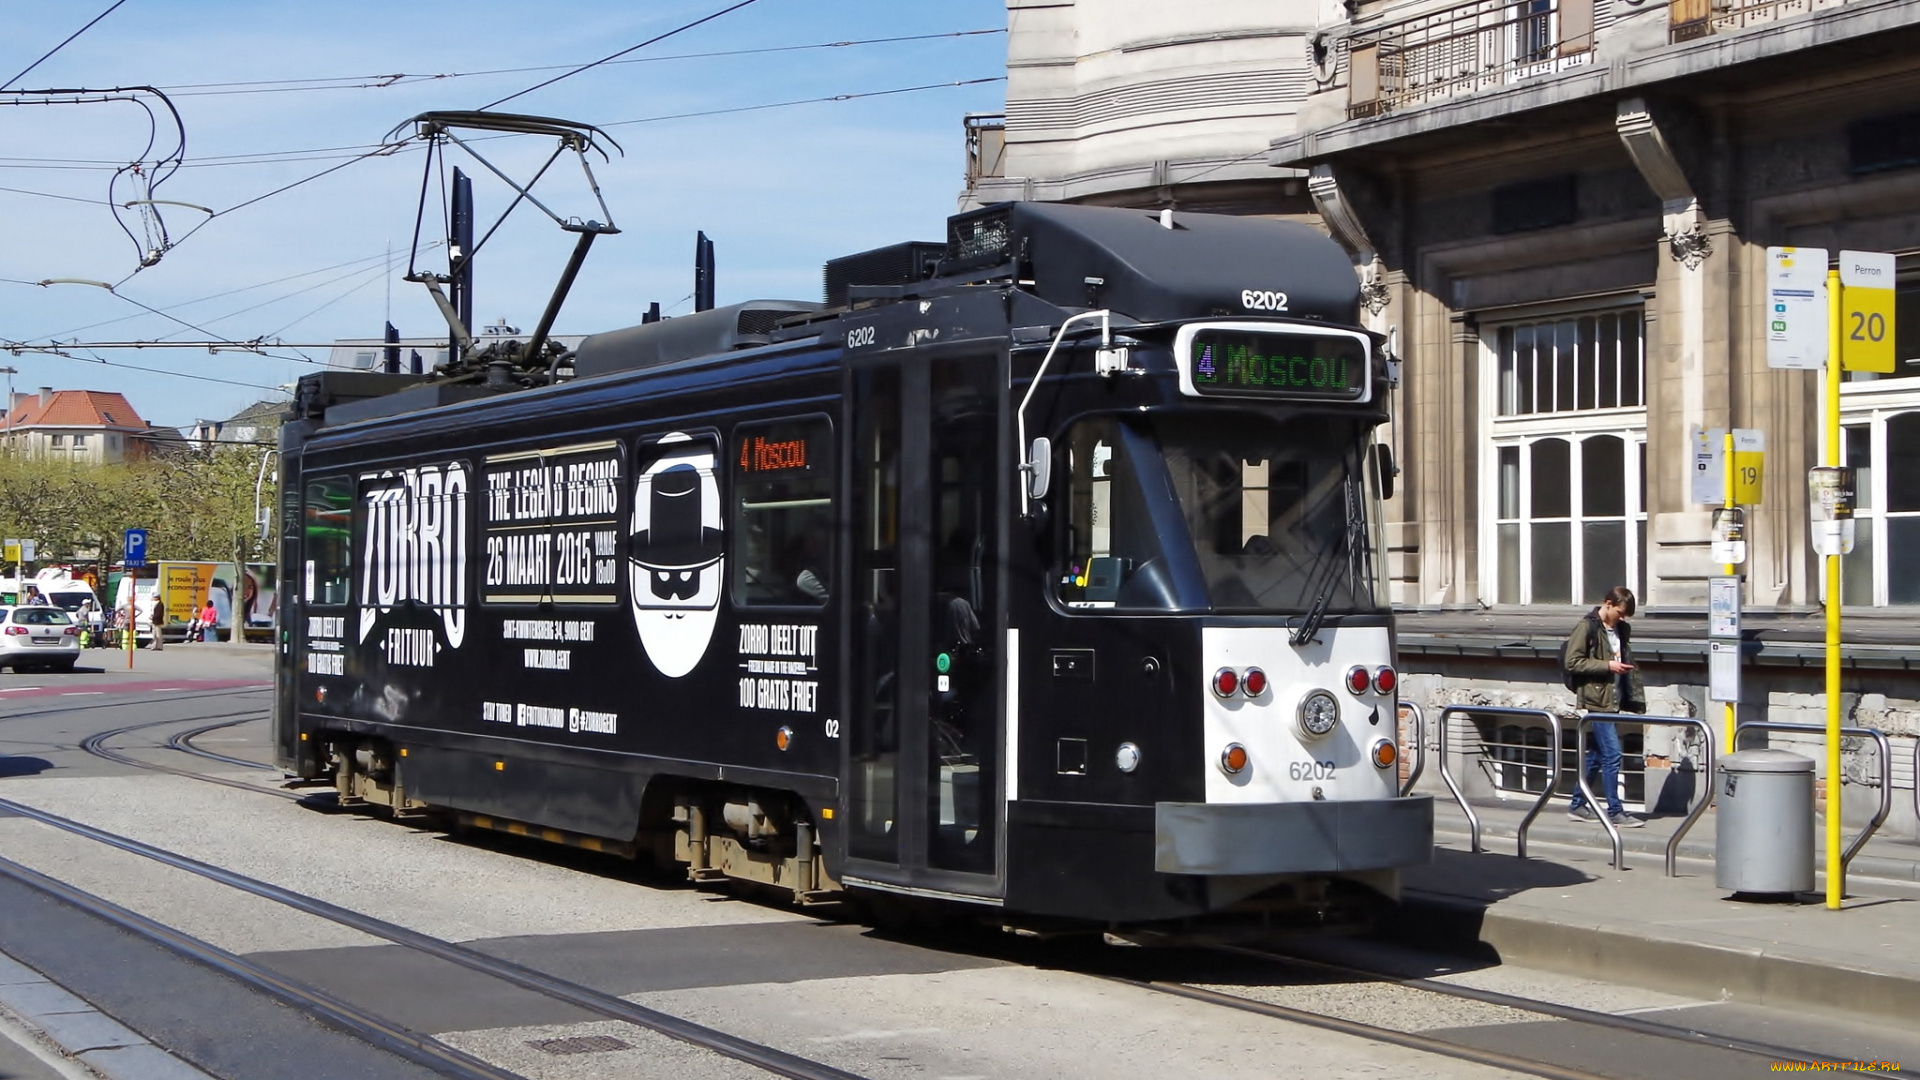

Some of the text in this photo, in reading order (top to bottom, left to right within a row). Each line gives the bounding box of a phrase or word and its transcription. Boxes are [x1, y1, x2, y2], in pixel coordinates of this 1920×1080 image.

[1854, 264, 1882, 276] Perron
[1241, 289, 1288, 311] 6202
[848, 326, 875, 349] 6202
[1773, 322, 1785, 330] N4
[1850, 311, 1886, 342] 20
[1198, 344, 1216, 379] 4
[740, 436, 806, 472] 4 Moscou
[1740, 467, 1757, 485] 19
[487, 458, 619, 522] THE LEGEND BEGINS
[128, 533, 143, 554] P
[359, 461, 467, 649] ZORRO
[487, 531, 591, 586] 26 MAART 2015
[564, 620, 579, 641] 9000
[580, 621, 595, 641] GENT
[739, 624, 818, 656] ZORRO DEELT UIT
[387, 627, 433, 667] FRITUUR
[739, 678, 819, 713] 100 GRATIS FRIET
[825, 718, 840, 738] 02
[1289, 761, 1336, 781] 6202
